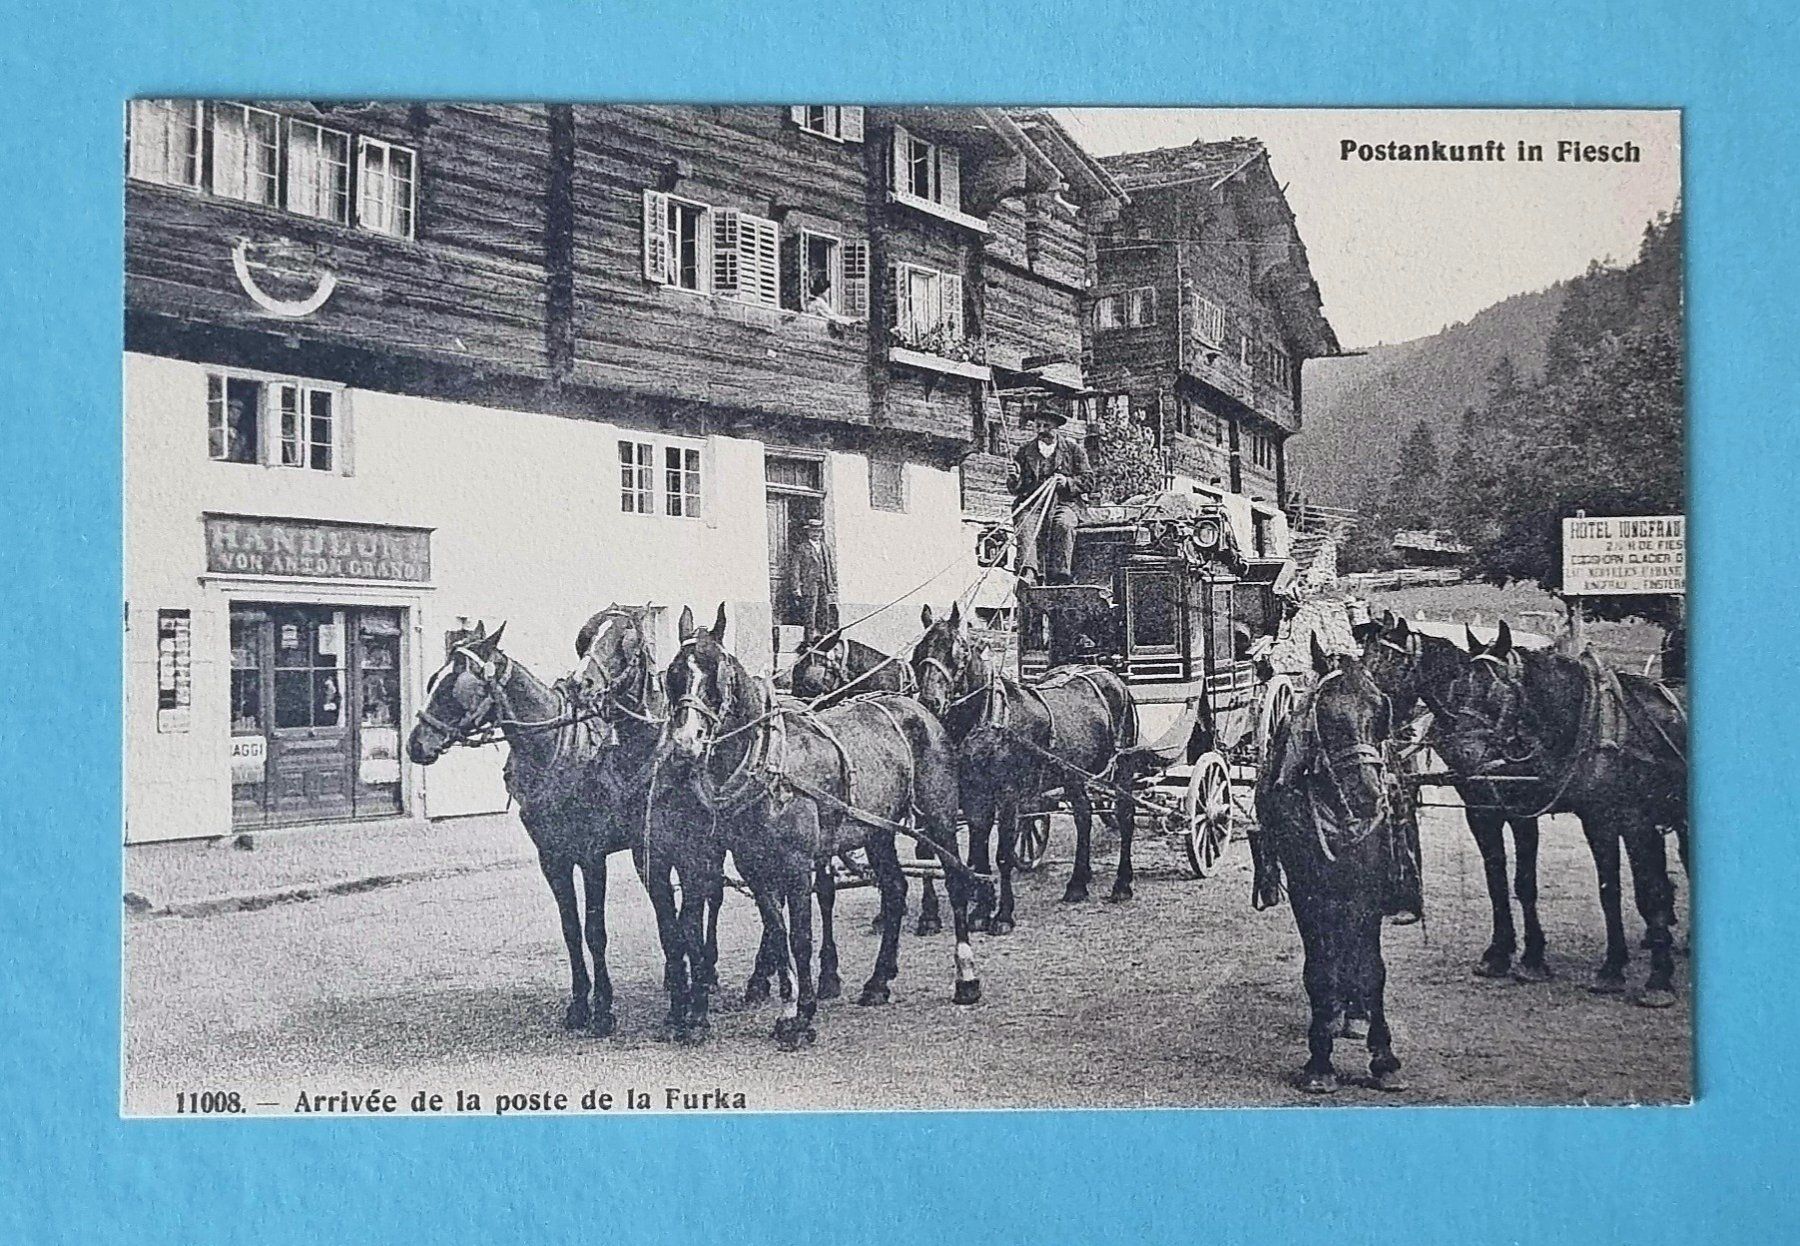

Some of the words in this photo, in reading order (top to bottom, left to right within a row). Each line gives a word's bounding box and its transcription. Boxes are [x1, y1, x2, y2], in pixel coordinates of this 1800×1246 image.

[1340, 139, 1506, 162] Postankunft
[1517, 140, 1543, 162] in
[1557, 141, 1641, 163] Fiesch
[1570, 522, 1612, 539] HOTEL
[219, 552, 263, 571] VON
[231, 744, 263, 757] AGGI
[176, 1090, 247, 1114] 11008.
[294, 1089, 397, 1113] Arrivée
[410, 1091, 444, 1112] de
[456, 1090, 481, 1112] la
[495, 1091, 568, 1115] poste
[581, 1089, 613, 1111] de
[627, 1088, 651, 1110] la
[665, 1087, 747, 1110] Furka
